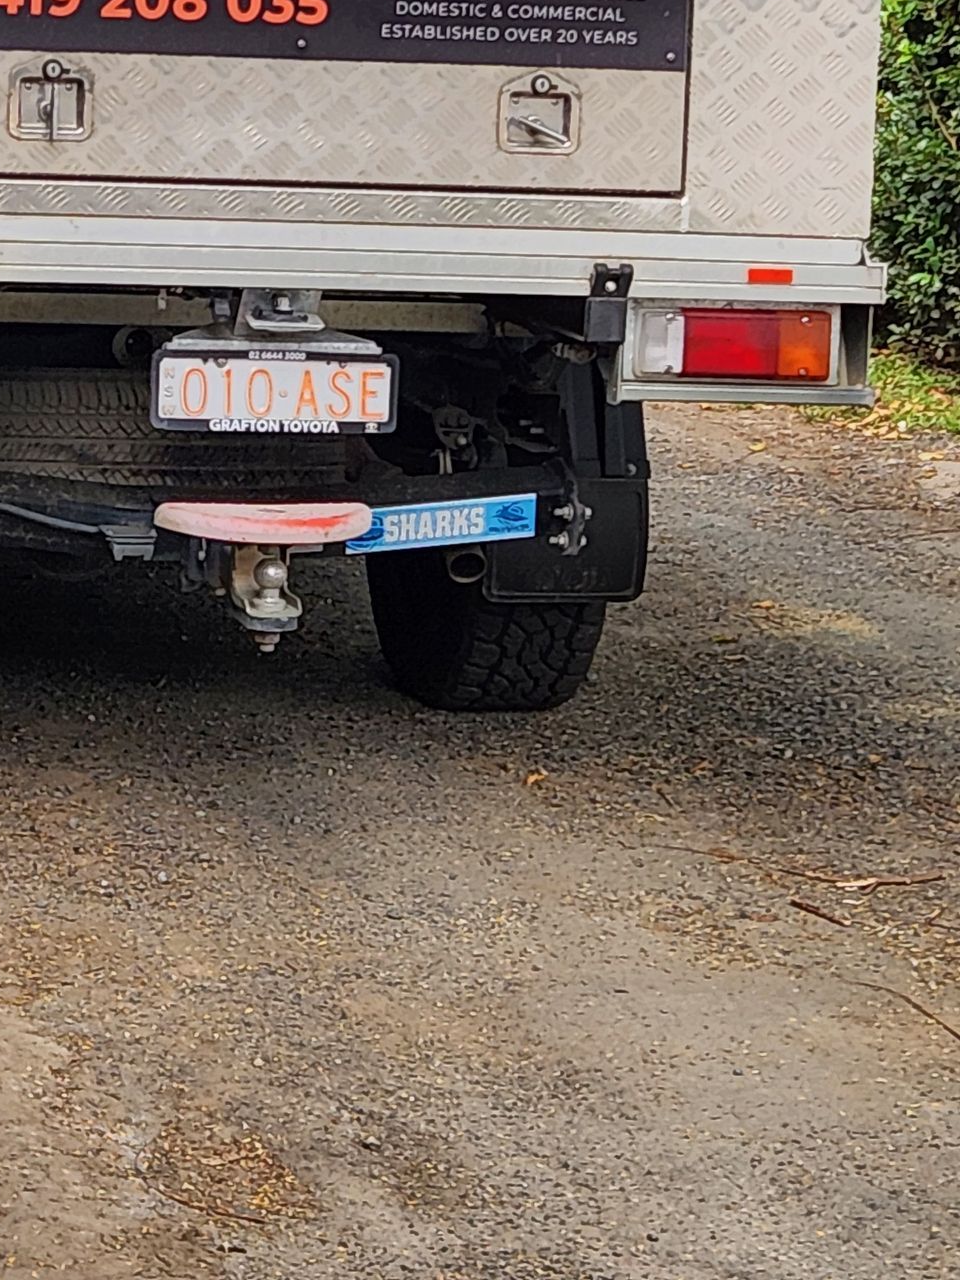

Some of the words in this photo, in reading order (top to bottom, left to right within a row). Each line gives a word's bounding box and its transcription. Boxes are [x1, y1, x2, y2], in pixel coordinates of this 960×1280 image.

[395, 0, 488, 18] DOMESTIC
[491, 3, 504, 18] &
[506, 4, 626, 22] COMMERCIAL
[380, 23, 500, 41] ESTABLISHED
[504, 27, 552, 43] OVER
[556, 28, 578, 43] 20
[582, 29, 638, 45] YEARS
[208, 418, 280, 433] GRAFTON
[283, 419, 339, 434] TOYOTA
[384, 507, 485, 543] SHARKS
